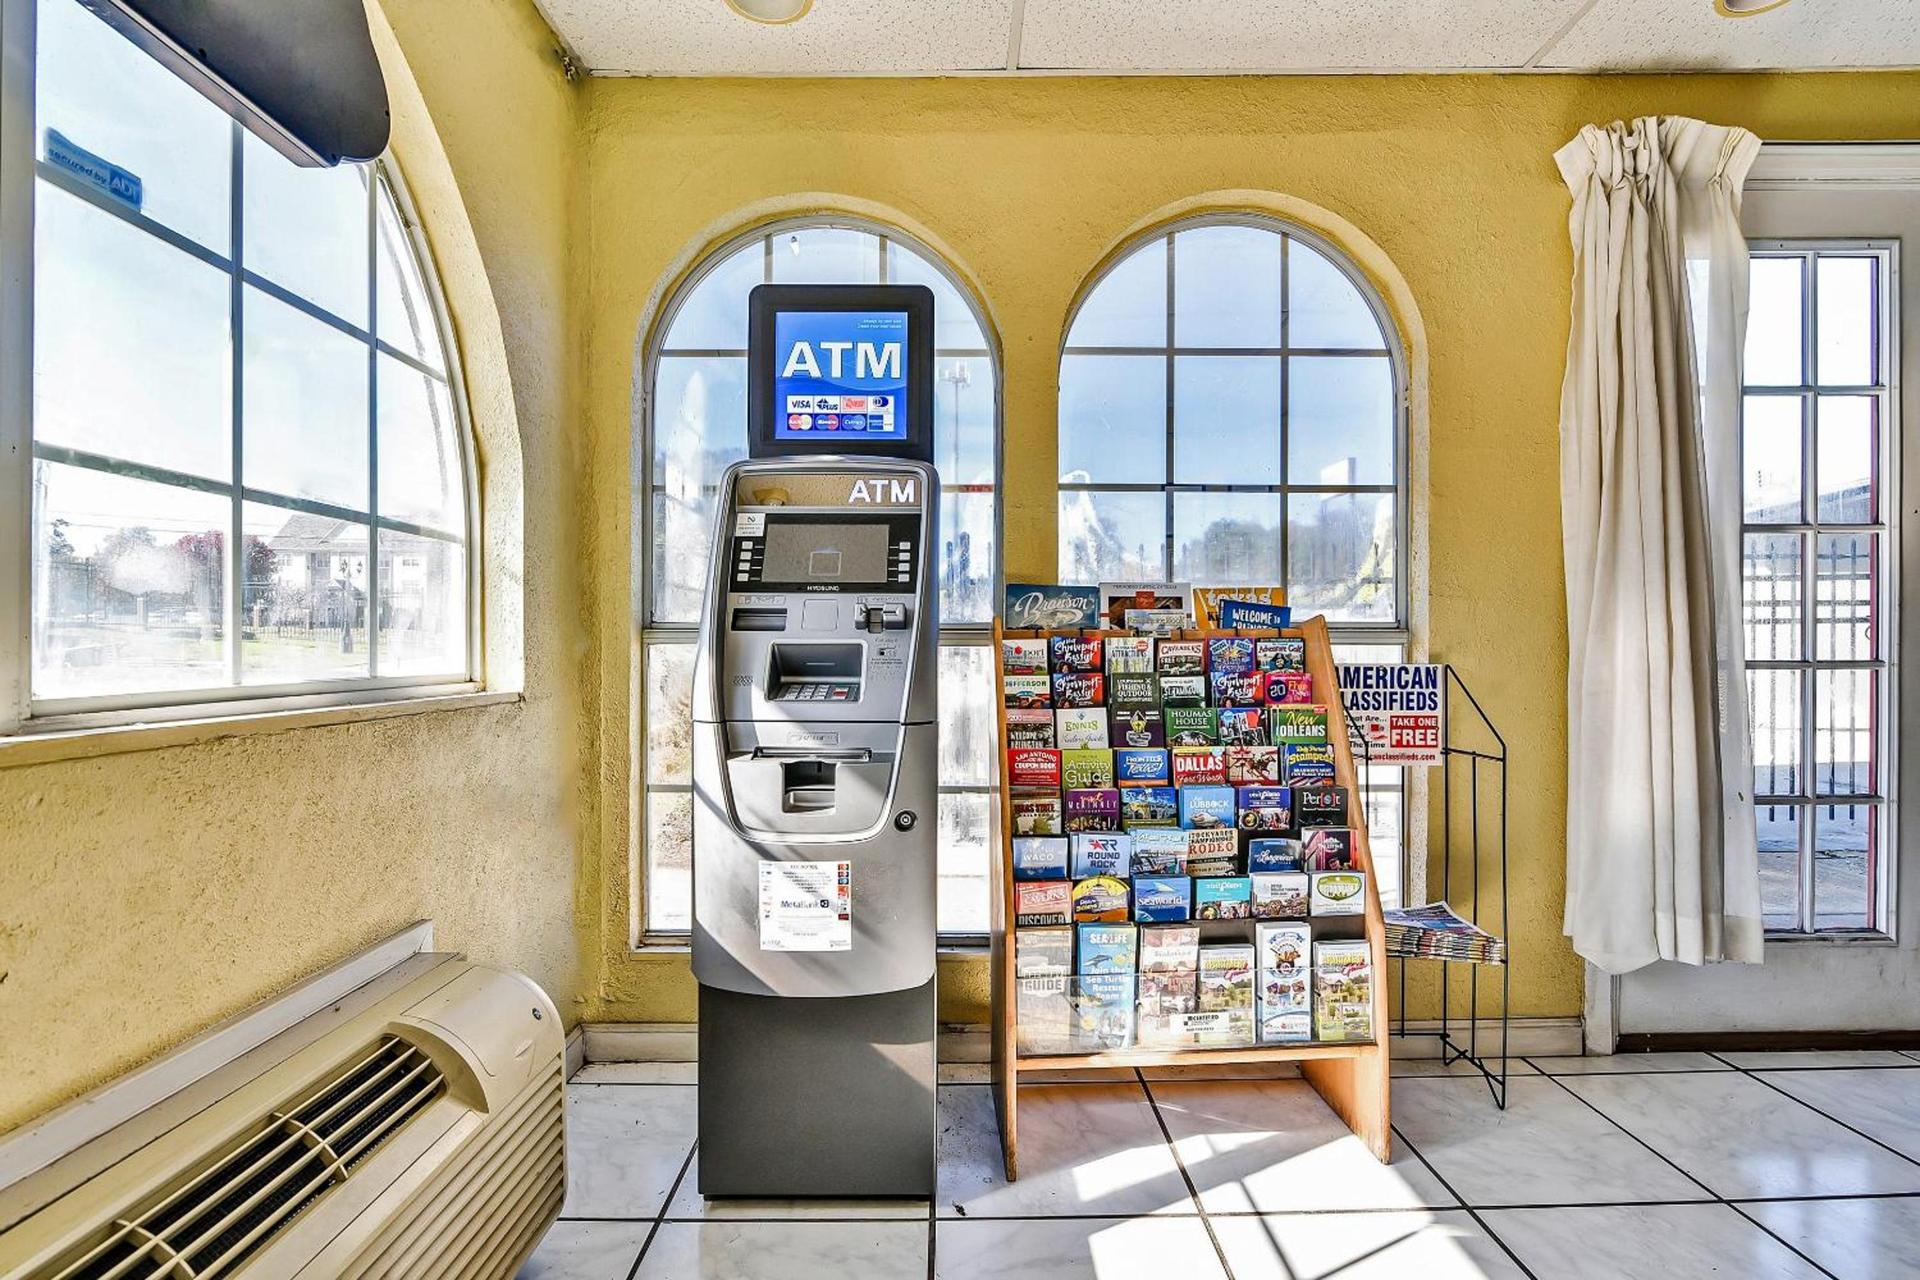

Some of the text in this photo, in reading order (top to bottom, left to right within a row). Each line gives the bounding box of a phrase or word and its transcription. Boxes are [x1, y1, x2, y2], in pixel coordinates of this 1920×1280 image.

[49, 149, 93, 177] secured
[93, 172, 107, 185] by
[781, 340, 902, 379] ATM
[792, 399, 811, 409] VISA
[849, 479, 915, 504] ATM
[1014, 592, 1088, 619] Branson
[1232, 608, 1273, 624] WELCOME
[1271, 684, 1286, 697] 20
[1286, 711, 1319, 725] New
[1391, 717, 1437, 726] TAKE ONE
[1064, 720, 1098, 731] ENNIS
[1280, 725, 1326, 737] ORLEANS
[1391, 729, 1437, 746] FREE
[1015, 752, 1057, 762] SAN ANTONIO
[1065, 760, 1111, 771] Activity
[1176, 756, 1223, 772] DALLAS
[1065, 769, 1112, 788] Guide
[1080, 792, 1104, 803] visit
[1188, 842, 1234, 855] RODEO
[1023, 853, 1054, 862] WACO
[1087, 852, 1120, 860] ROUND
[1089, 861, 1116, 869] ROCK
[1024, 888, 1066, 905] CAVERNS
[1089, 933, 1108, 944] SEA
[1024, 979, 1064, 991] GUIDE
[1086, 975, 1102, 983] Sea
